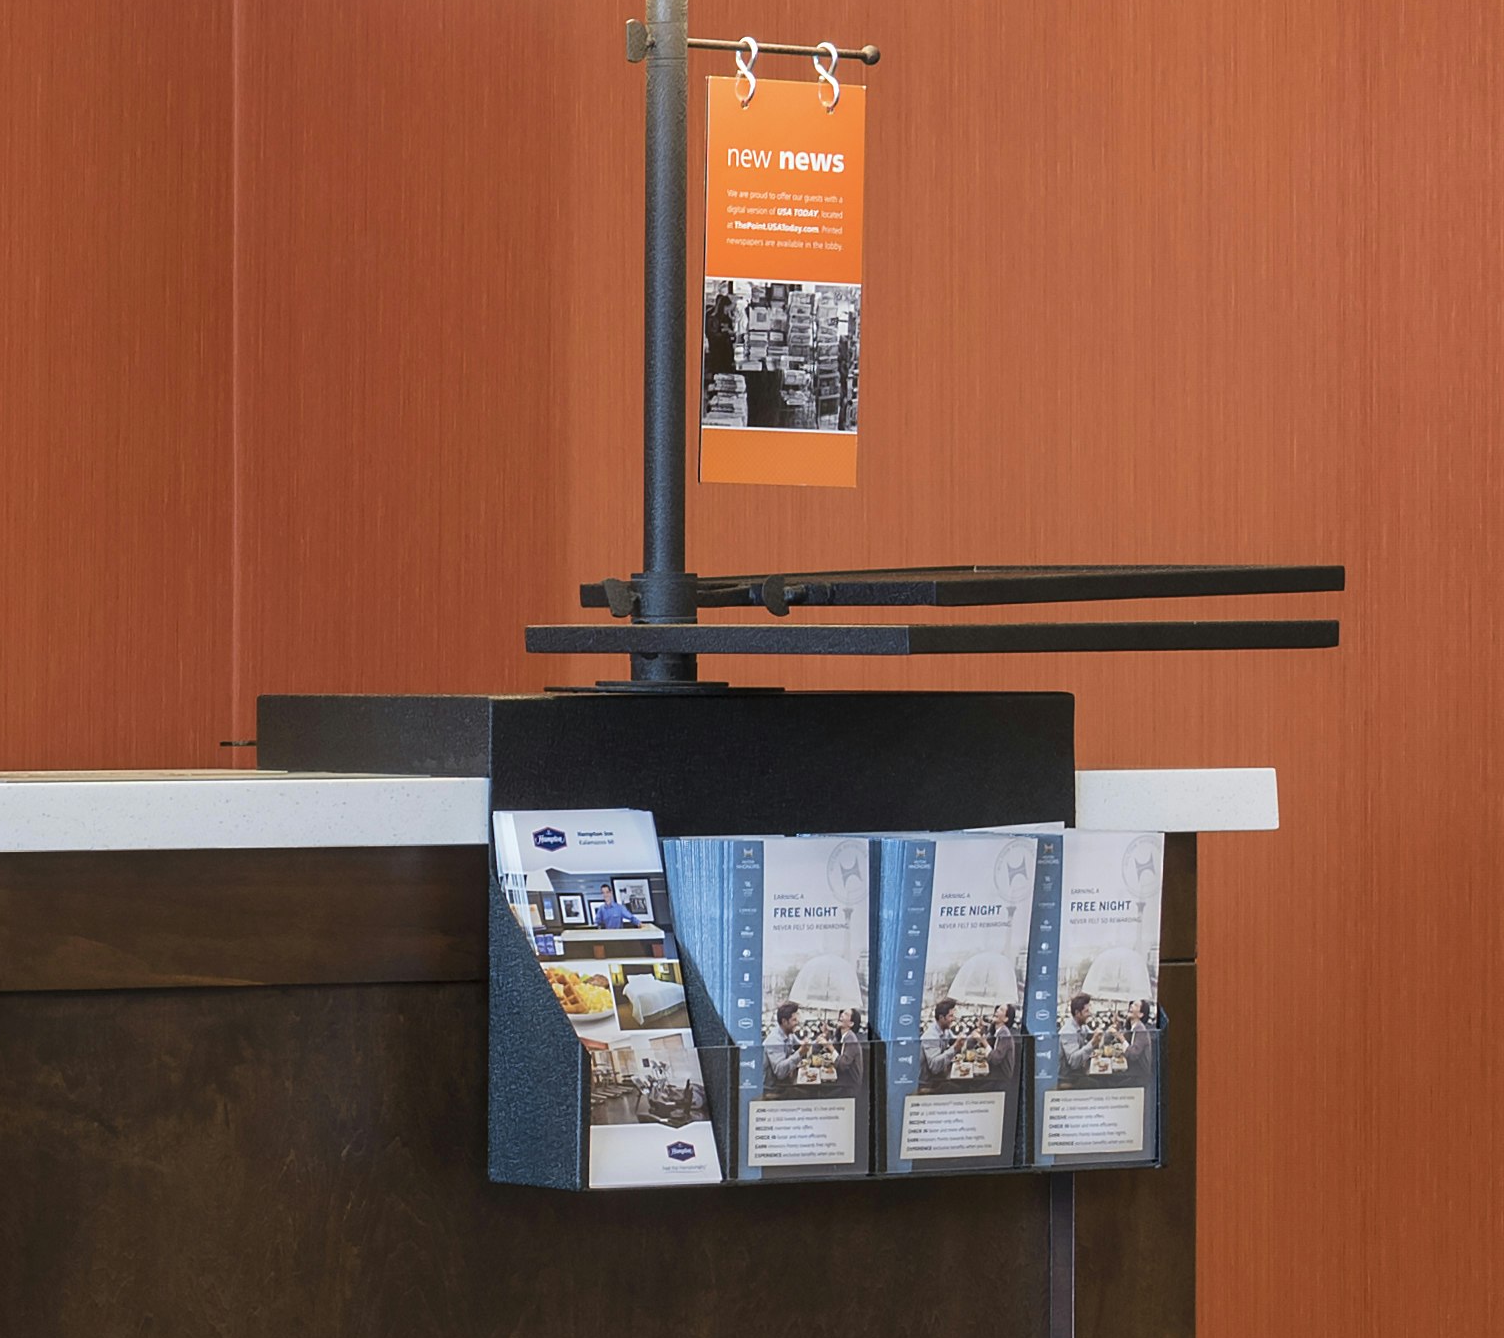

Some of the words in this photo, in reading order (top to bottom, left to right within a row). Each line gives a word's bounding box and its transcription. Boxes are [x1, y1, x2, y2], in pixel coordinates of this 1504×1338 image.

[727, 147, 773, 169] new
[779, 150, 845, 173] news
[726, 188, 738, 198] We
[750, 191, 768, 200] proud
[769, 192, 776, 200] to
[776, 192, 792, 201] offer
[803, 194, 823, 204] guests
[726, 205, 746, 216] digital
[746, 207, 767, 215] version
[769, 207, 776, 216] of
[776, 207, 793, 217] USA
[726, 237, 764, 247] newspapers
[764, 239, 776, 247] are
[776, 239, 804, 249] available
[812, 241, 823, 250] the
[536, 834, 565, 845] Hampton
[773, 907, 801, 918] FREE
[804, 906, 839, 918] NIGHT
[940, 906, 966, 917] FREE
[969, 905, 1002, 916] NIGHT
[1070, 901, 1096, 912] FREE
[1099, 900, 1132, 911] NIGHT
